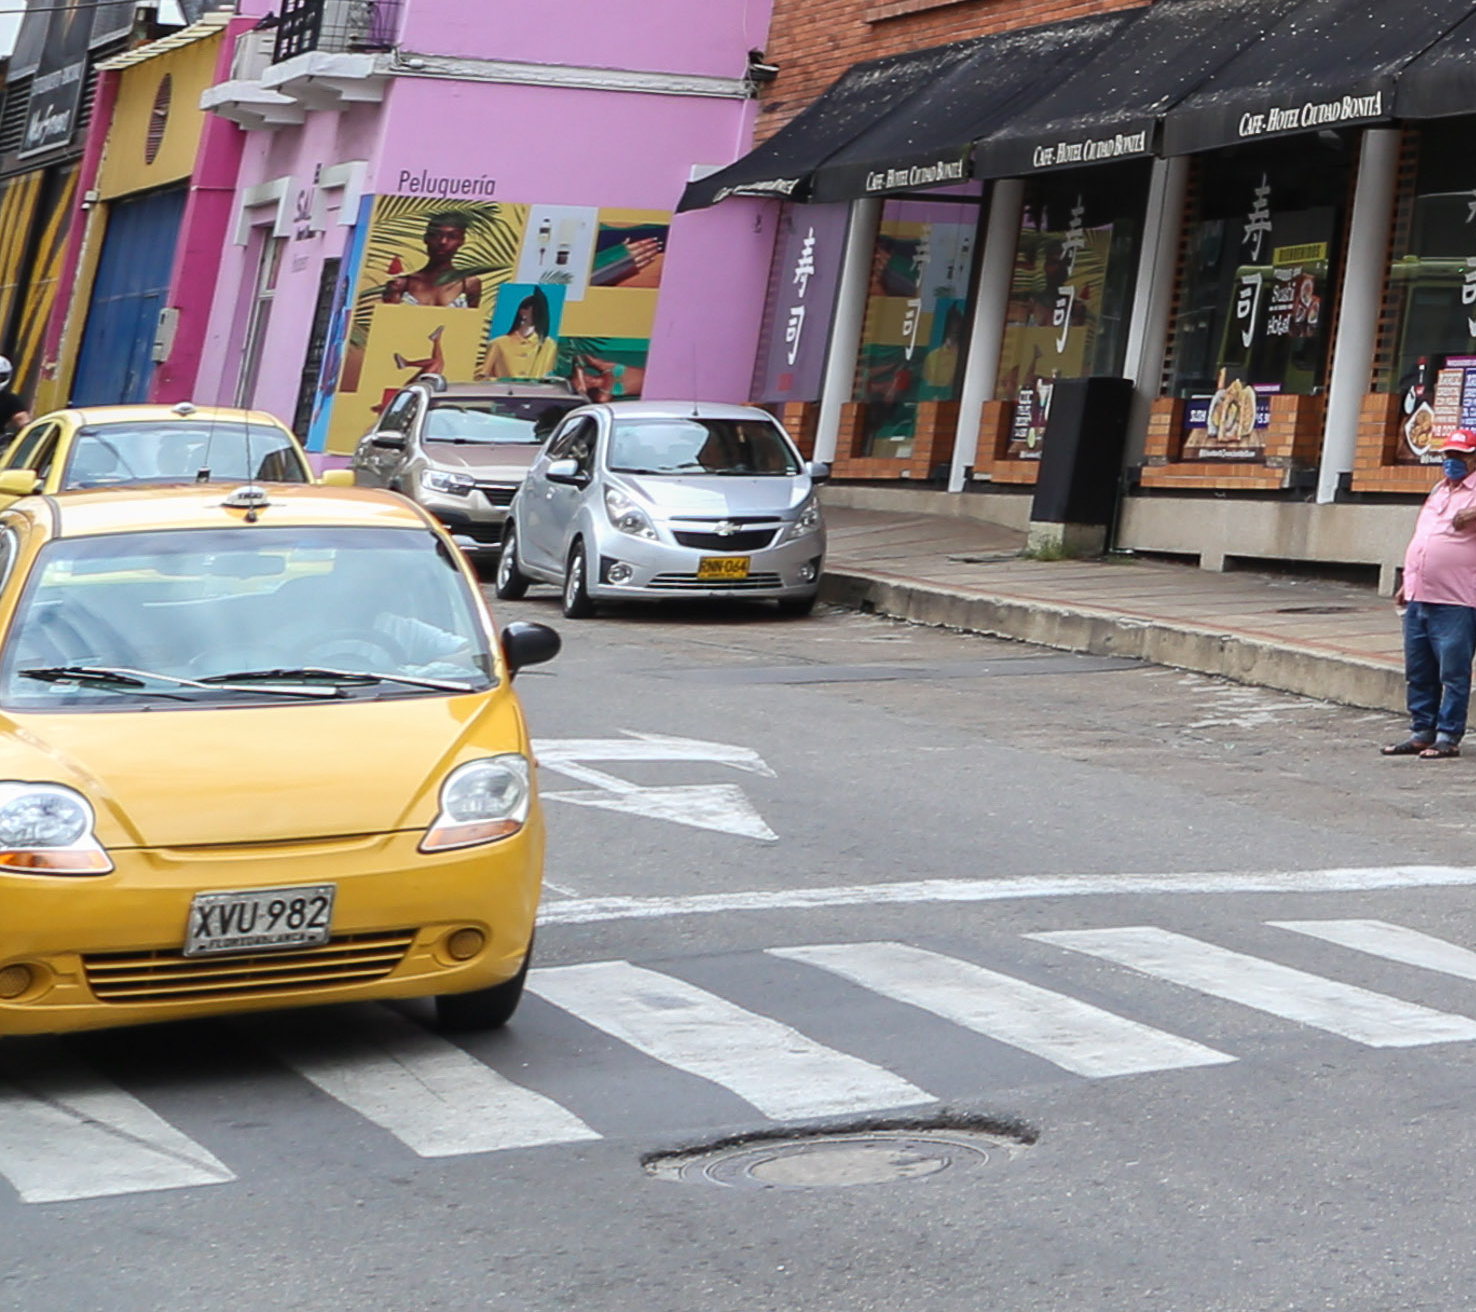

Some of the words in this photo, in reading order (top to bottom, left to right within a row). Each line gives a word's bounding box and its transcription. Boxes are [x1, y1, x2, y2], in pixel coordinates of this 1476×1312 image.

[1266, 106, 1300, 133] HOTEL
[1300, 102, 1340, 129] CIUDAD
[1341, 91, 1382, 121] BONITA
[398, 169, 496, 198] Peluquería
